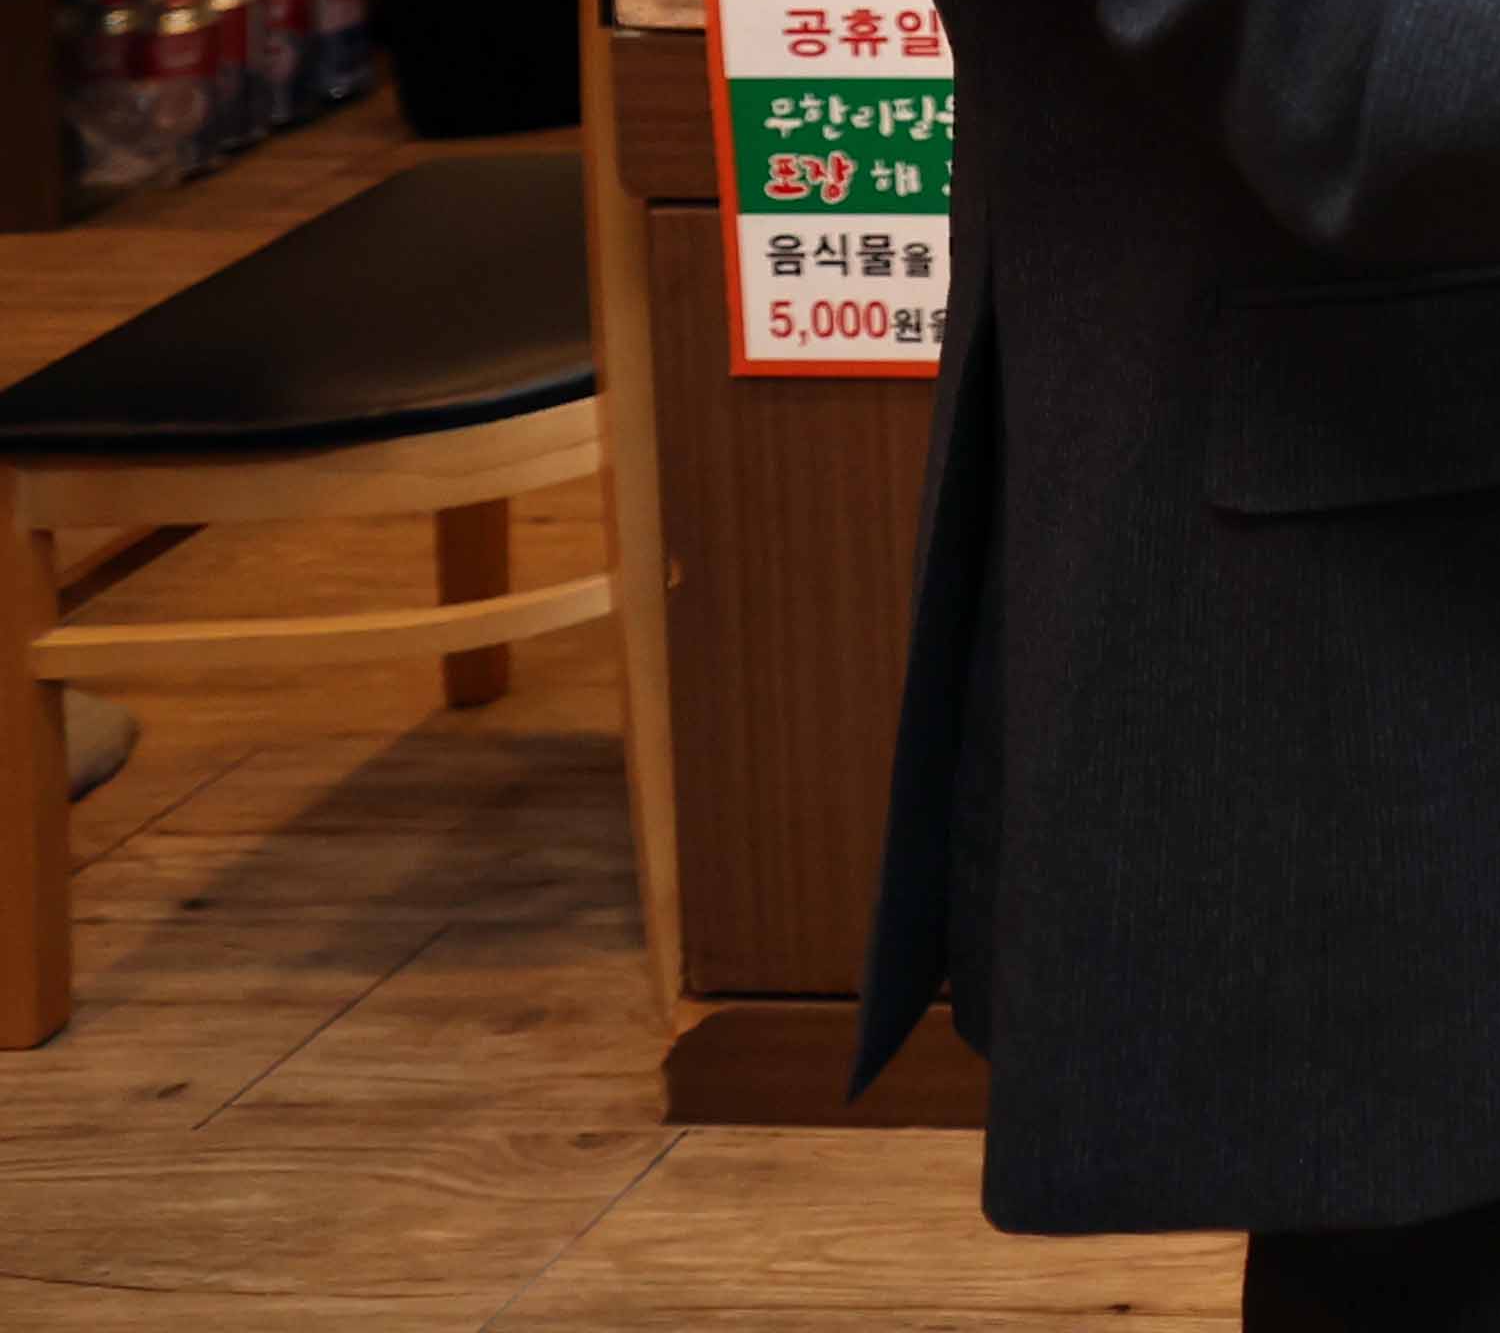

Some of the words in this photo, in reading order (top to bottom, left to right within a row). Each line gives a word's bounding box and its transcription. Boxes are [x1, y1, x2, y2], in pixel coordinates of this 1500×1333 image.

[782, 9, 941, 58] 공휴일
[763, 149, 858, 205] 포장
[869, 158, 923, 198] 해
[766, 233, 933, 278] 음식물을
